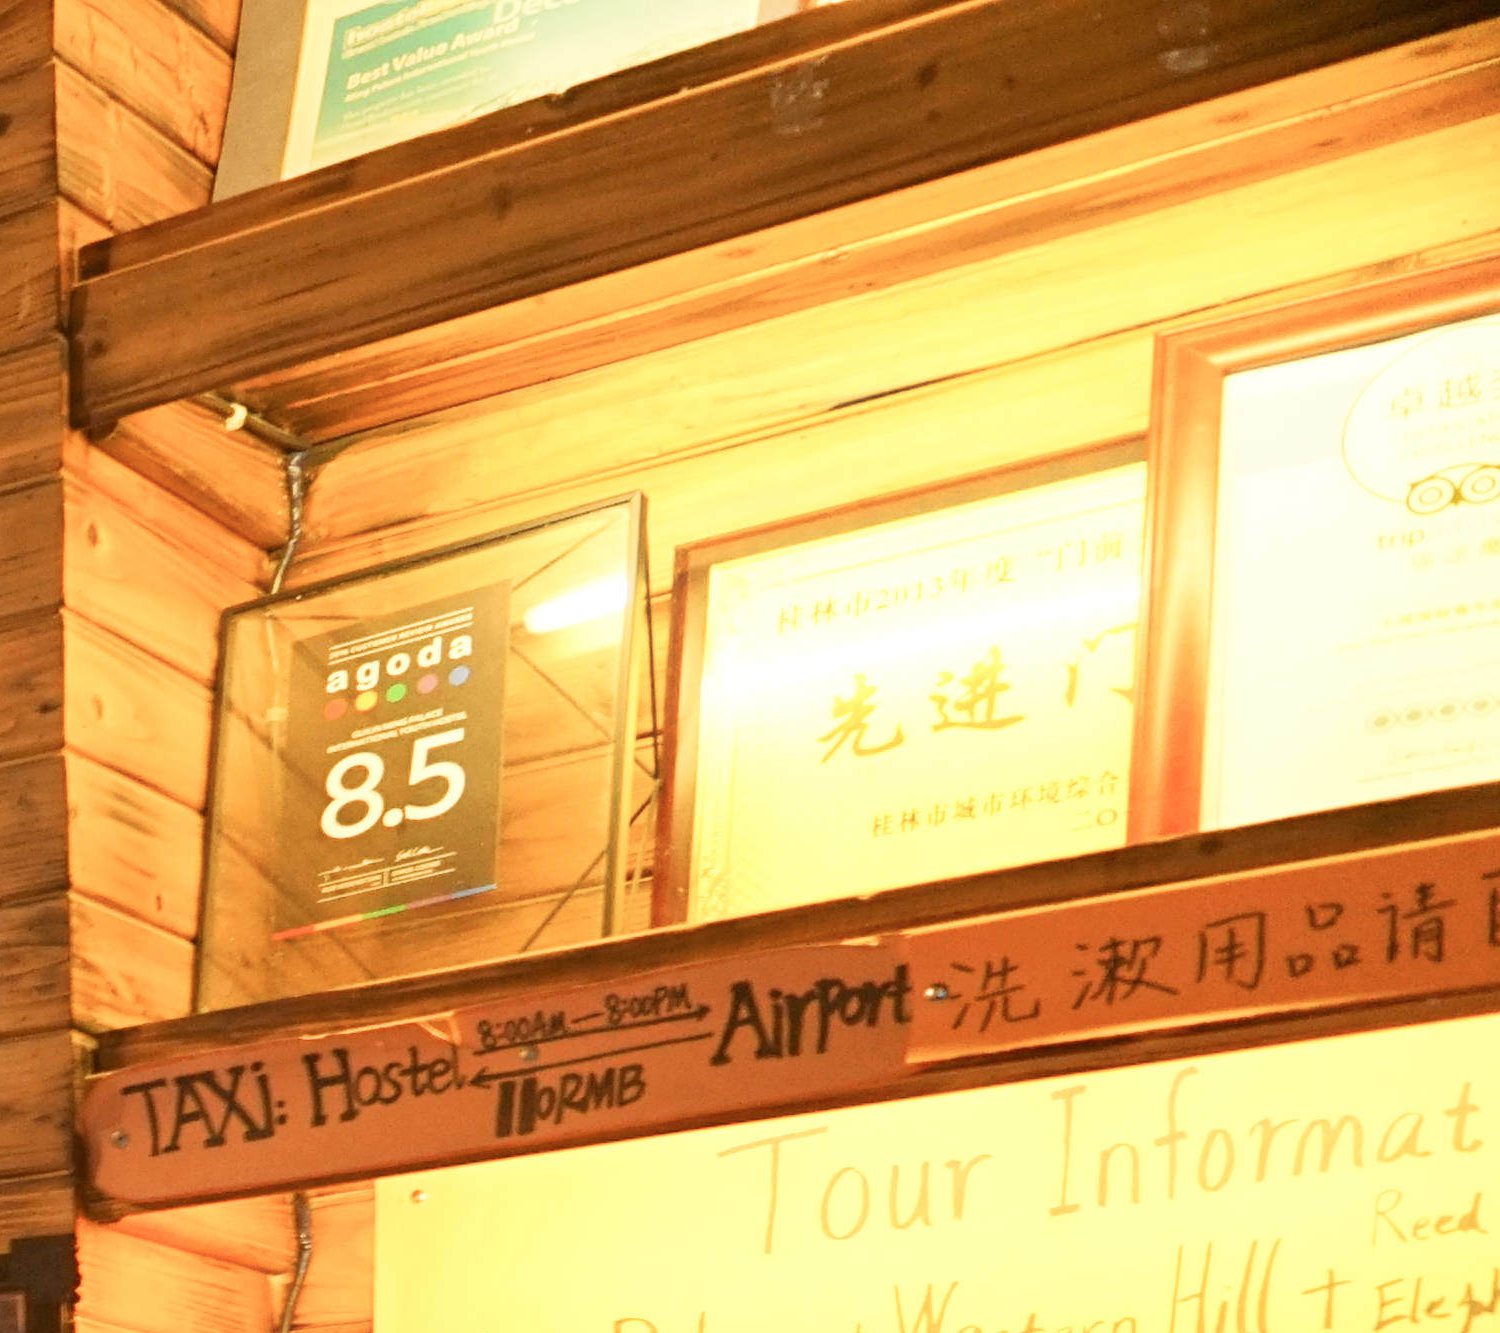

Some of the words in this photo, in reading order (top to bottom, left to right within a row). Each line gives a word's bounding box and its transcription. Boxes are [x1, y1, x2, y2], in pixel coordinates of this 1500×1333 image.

[346, 63, 390, 90] Best
[392, 42, 448, 71] Value
[451, 17, 521, 51] Award
[326, 634, 473, 694] agoda
[320, 728, 466, 839] 8.5
[303, 1046, 465, 1127] Hostel
[709, 964, 911, 1066] Airport
[717, 1127, 993, 1254] Tour
[1371, 1190, 1487, 1245] Reed
